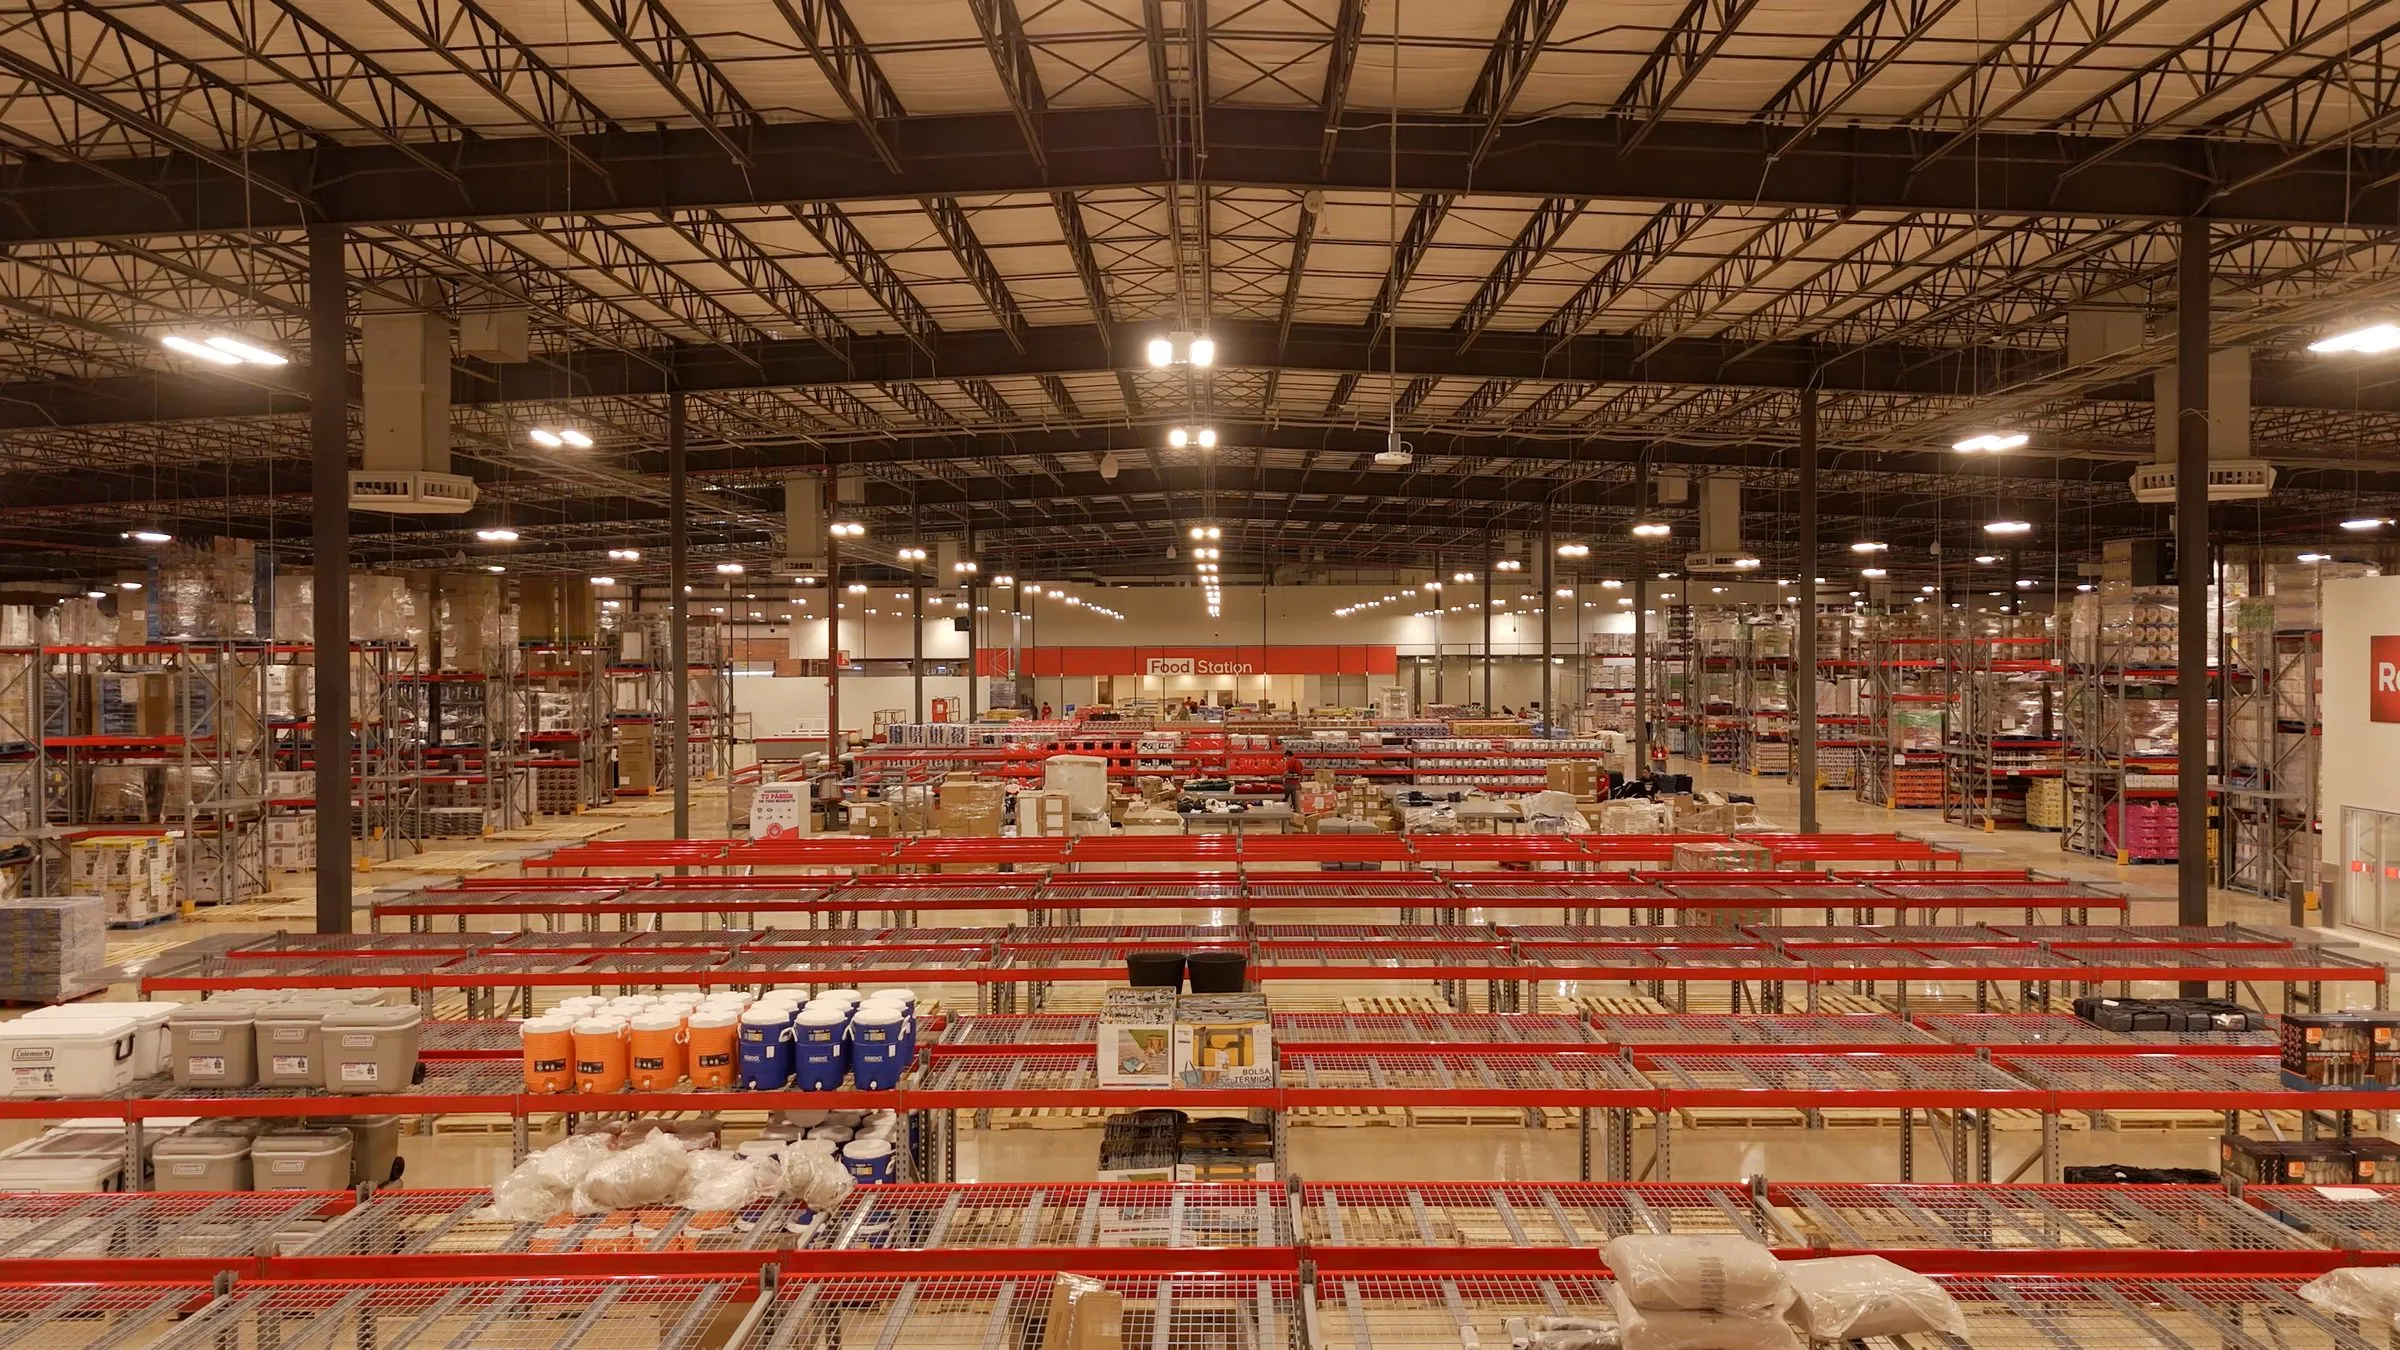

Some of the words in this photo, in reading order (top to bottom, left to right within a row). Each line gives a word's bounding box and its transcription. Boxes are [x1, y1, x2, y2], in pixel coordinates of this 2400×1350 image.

[1151, 660, 1190, 674] Food
[1197, 660, 1253, 674] Station
[2378, 661, 2400, 692] R
[15, 1049, 44, 1057] Coleman
[1242, 1068, 1270, 1076] BOLSA
[2289, 1163, 2295, 1173] 8
[2359, 1162, 2365, 1173] 8
